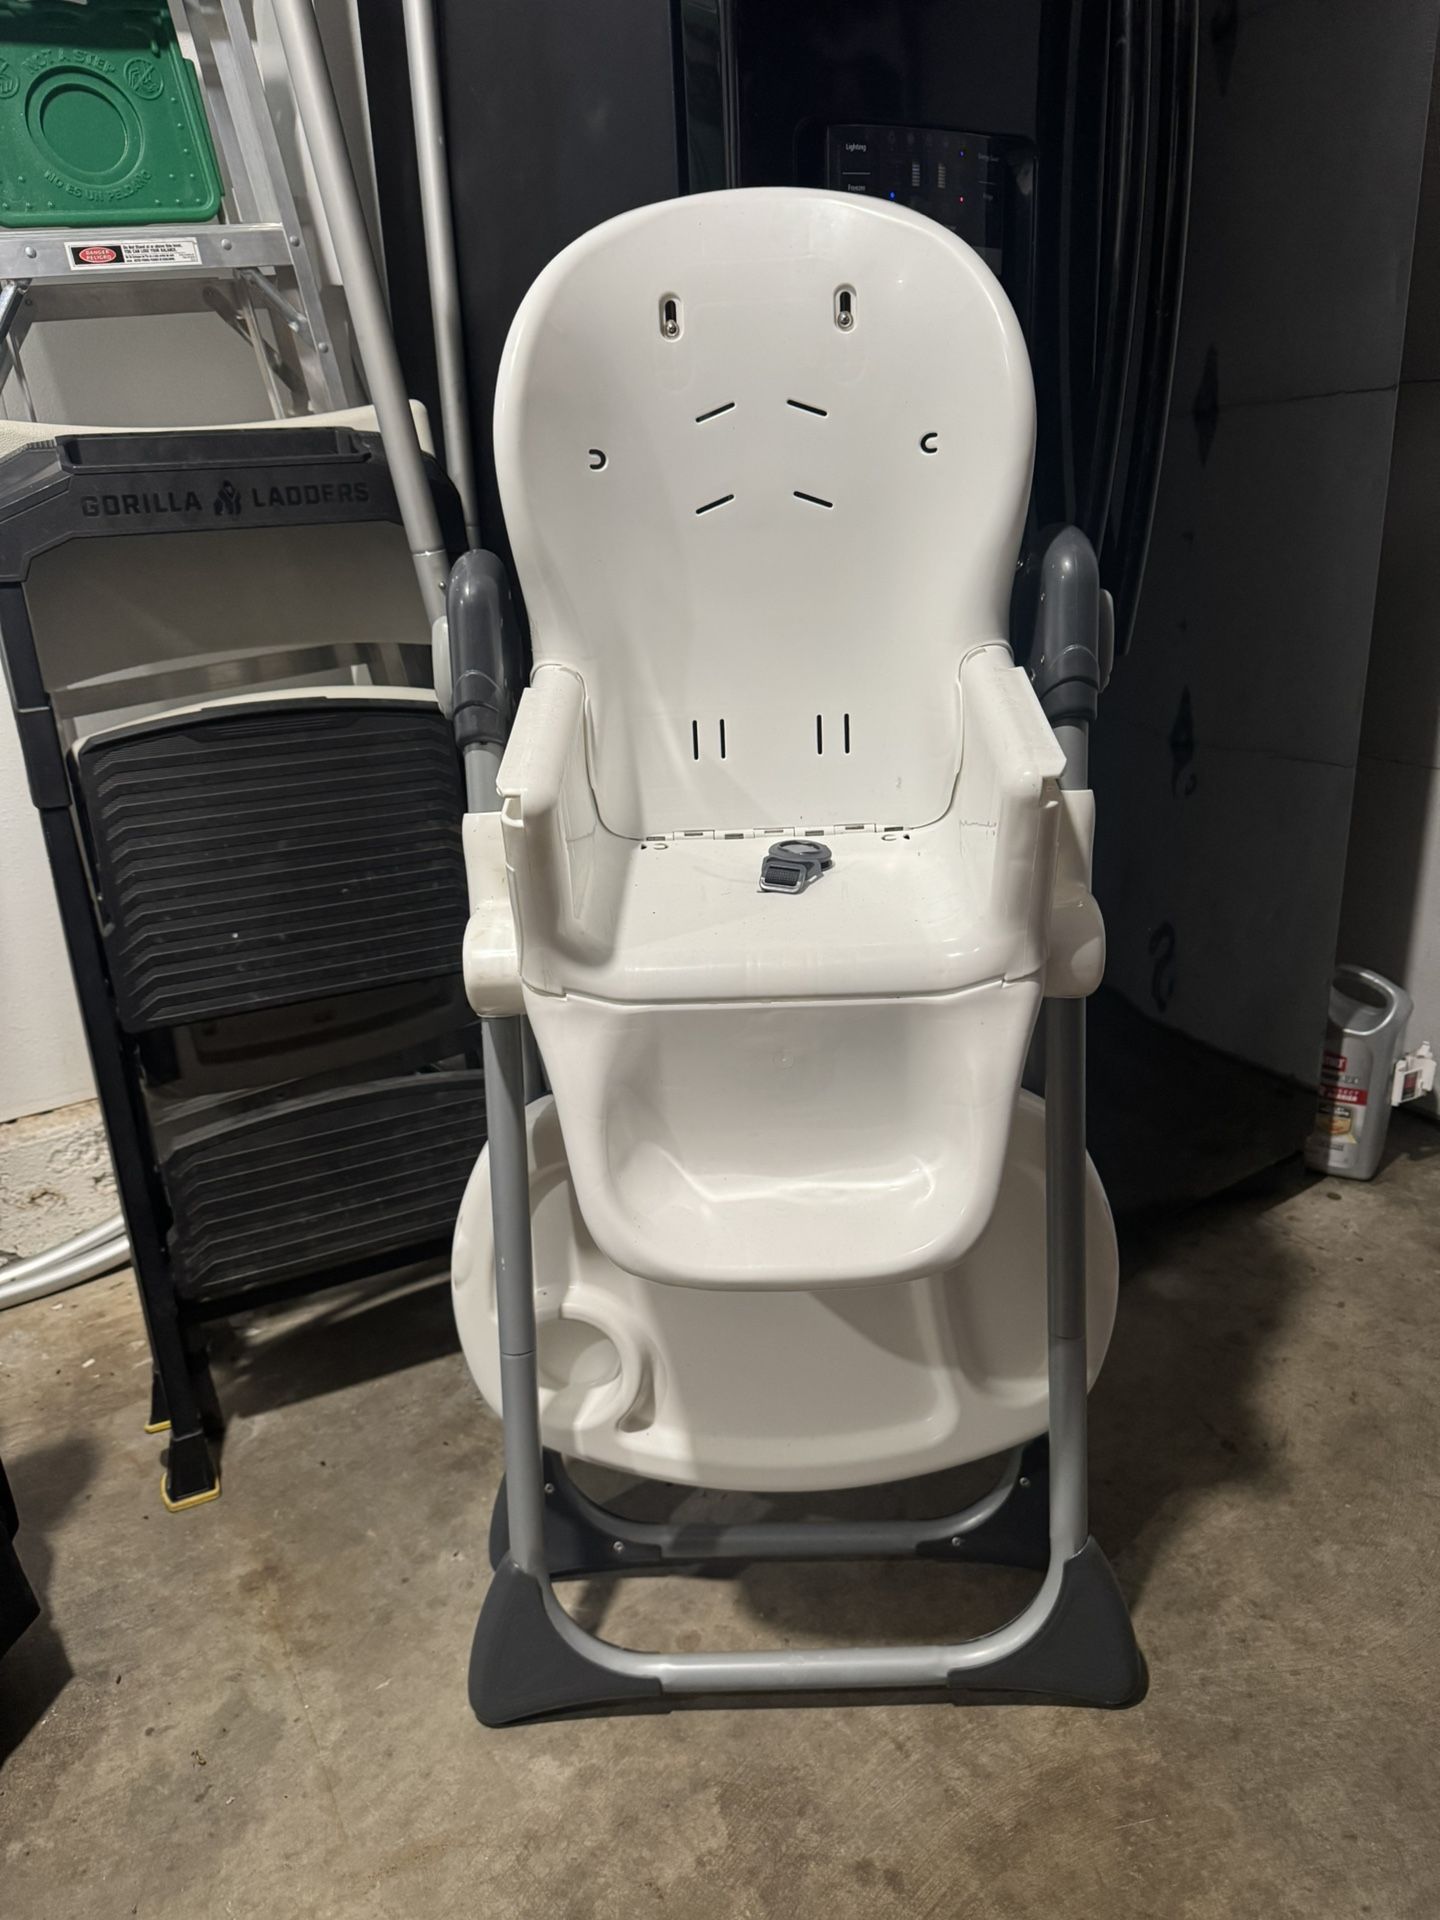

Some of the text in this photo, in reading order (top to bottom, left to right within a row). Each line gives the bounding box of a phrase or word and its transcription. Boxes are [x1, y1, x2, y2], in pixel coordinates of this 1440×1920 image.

[73, 49, 117, 74] STEP
[845, 143, 867, 153] Lighting
[44, 169, 65, 189] NO
[65, 183, 83, 198] ES
[82, 481, 371, 517] GORILLA LADDERS
